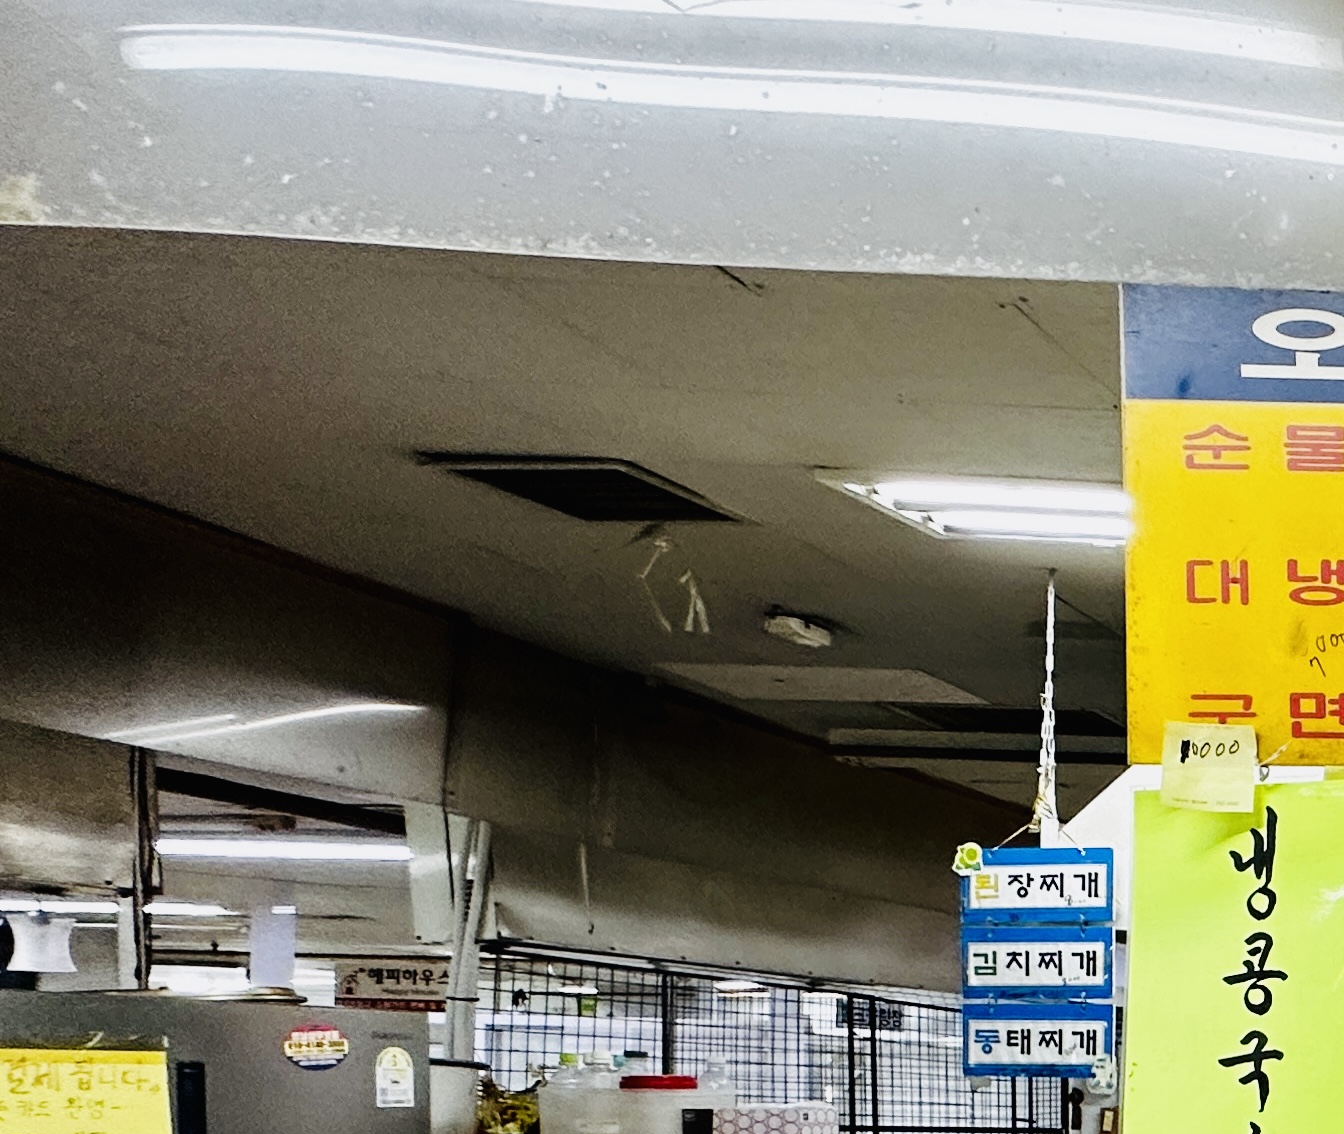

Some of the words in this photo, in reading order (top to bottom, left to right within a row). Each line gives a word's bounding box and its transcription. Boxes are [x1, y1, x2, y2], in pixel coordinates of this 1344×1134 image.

[974, 871, 1100, 899] 된장찌개
[972, 950, 1098, 978] 김치찌개
[973, 1028, 1098, 1056] 동태찌개
